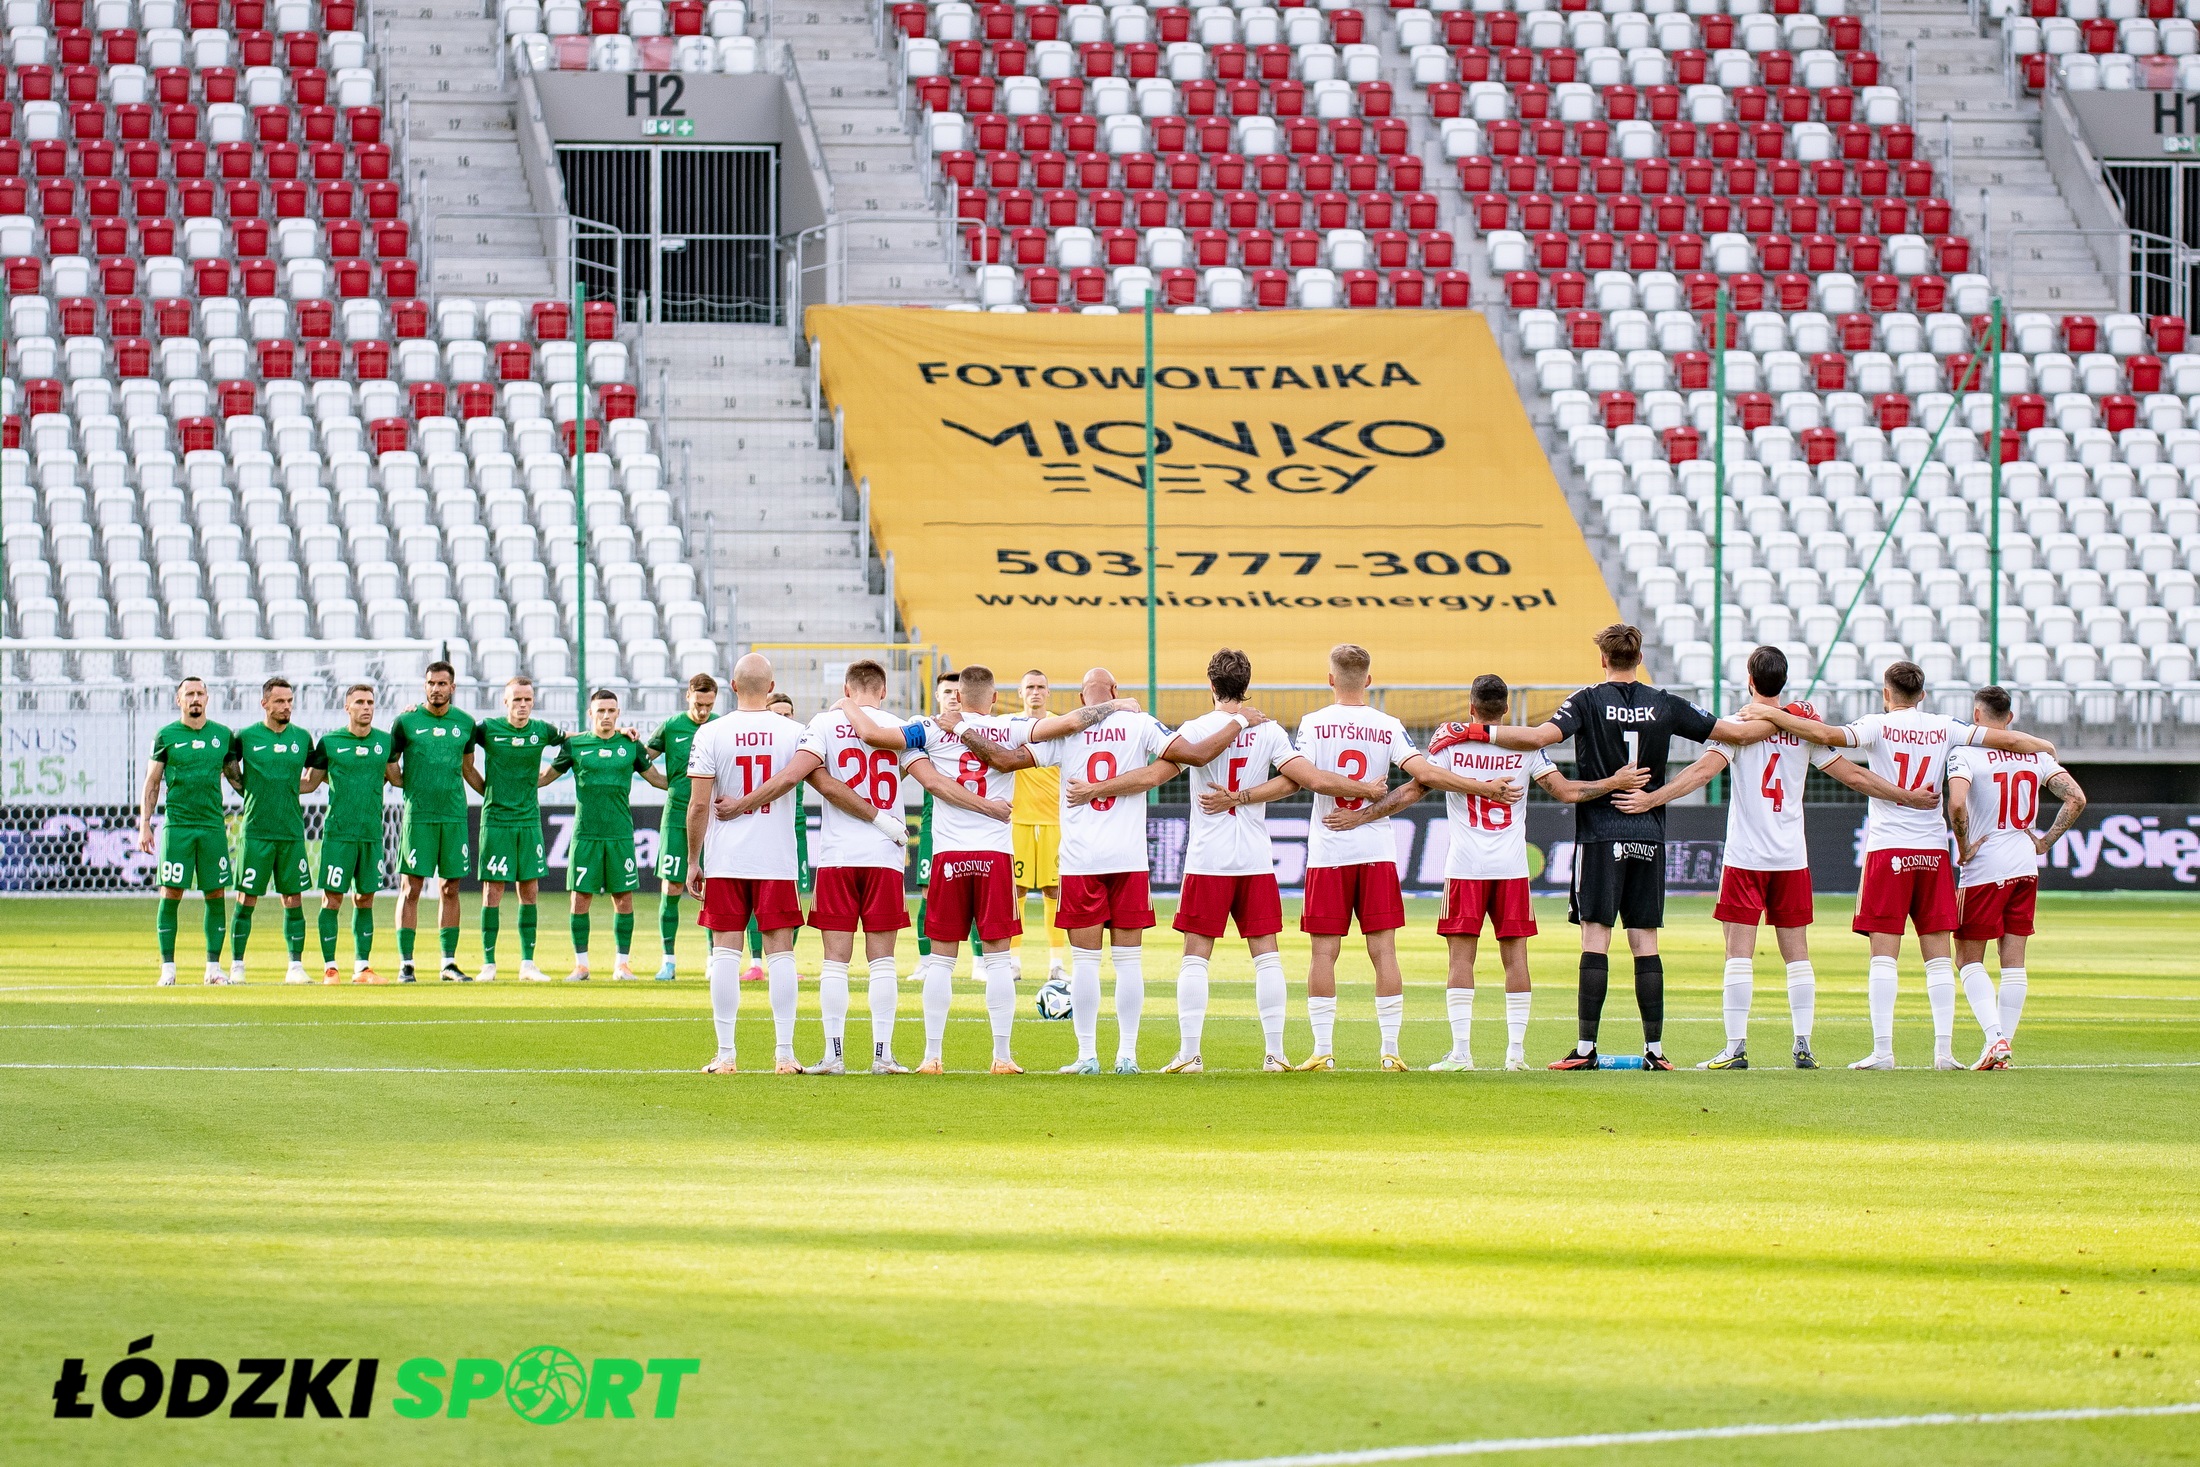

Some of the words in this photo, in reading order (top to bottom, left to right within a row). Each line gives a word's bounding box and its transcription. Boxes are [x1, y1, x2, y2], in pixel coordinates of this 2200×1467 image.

[627, 74, 686, 117] H2
[449, 118, 461, 130] 17
[2154, 92, 2200, 134] H1
[457, 155, 470, 167] 16
[854, 160, 867, 173] 16
[476, 232, 489, 245] 14
[877, 237, 890, 250] 14
[712, 354, 725, 367] 11
[918, 361, 1421, 390] FOTOWOLTAIKA
[724, 396, 737, 409] 10
[737, 437, 746, 450] 9
[1041, 463, 1378, 494] ENERGY
[760, 509, 767, 521] 7
[996, 548, 1512, 577] 503-777-300
[975, 588, 1558, 611] www.mionikoenergy.pl
[8, 726, 78, 753] NUS
[735, 732, 773, 747] HOTI
[1228, 732, 1257, 748] LIS
[1314, 722, 1393, 745] TUTYŠKINAS
[1882, 725, 1947, 745] MOKRZYCKI
[1453, 752, 1523, 771] RAMIREZ
[1623, 731, 1639, 771] 1
[9, 755, 96, 797] 15+
[735, 754, 772, 815] 11
[837, 747, 898, 810] 26
[956, 751, 989, 798] 8
[1334, 749, 1368, 811] 3
[1761, 752, 1784, 813] 4
[1993, 770, 2038, 830] 10
[405, 848, 417, 869] 4
[487, 854, 509, 877] 44
[661, 854, 681, 877] 21
[952, 860, 992, 874] COSINUS
[1901, 854, 1940, 868] COSINUS
[161, 860, 184, 884] 99
[242, 867, 257, 889] 2
[327, 863, 344, 888] 16
[576, 866, 588, 887] 7
